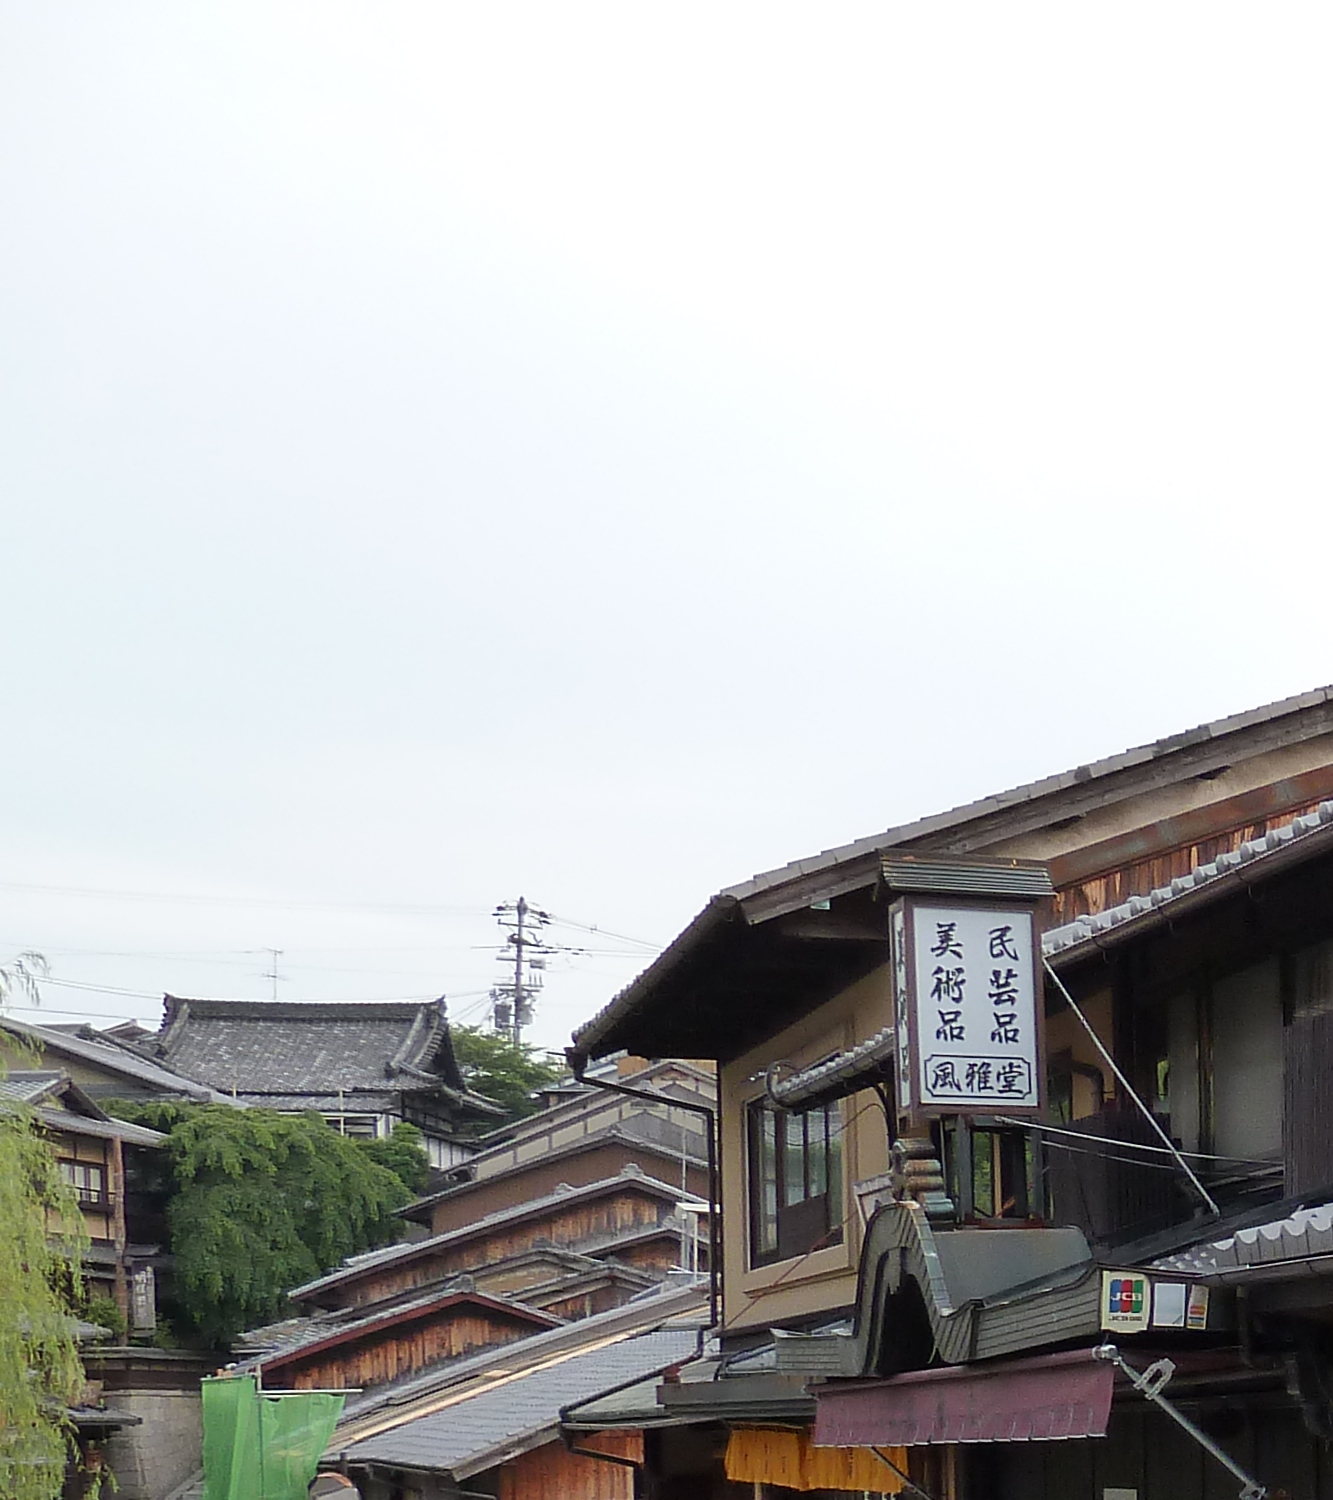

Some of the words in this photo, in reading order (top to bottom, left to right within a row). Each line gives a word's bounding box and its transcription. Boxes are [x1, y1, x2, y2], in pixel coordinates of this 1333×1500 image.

[930, 922, 967, 1042] 美術品
[987, 925, 1020, 1045] 民芸品
[931, 1061, 1025, 1095] 風雅堂
[1110, 1291, 1142, 1301] JCB
